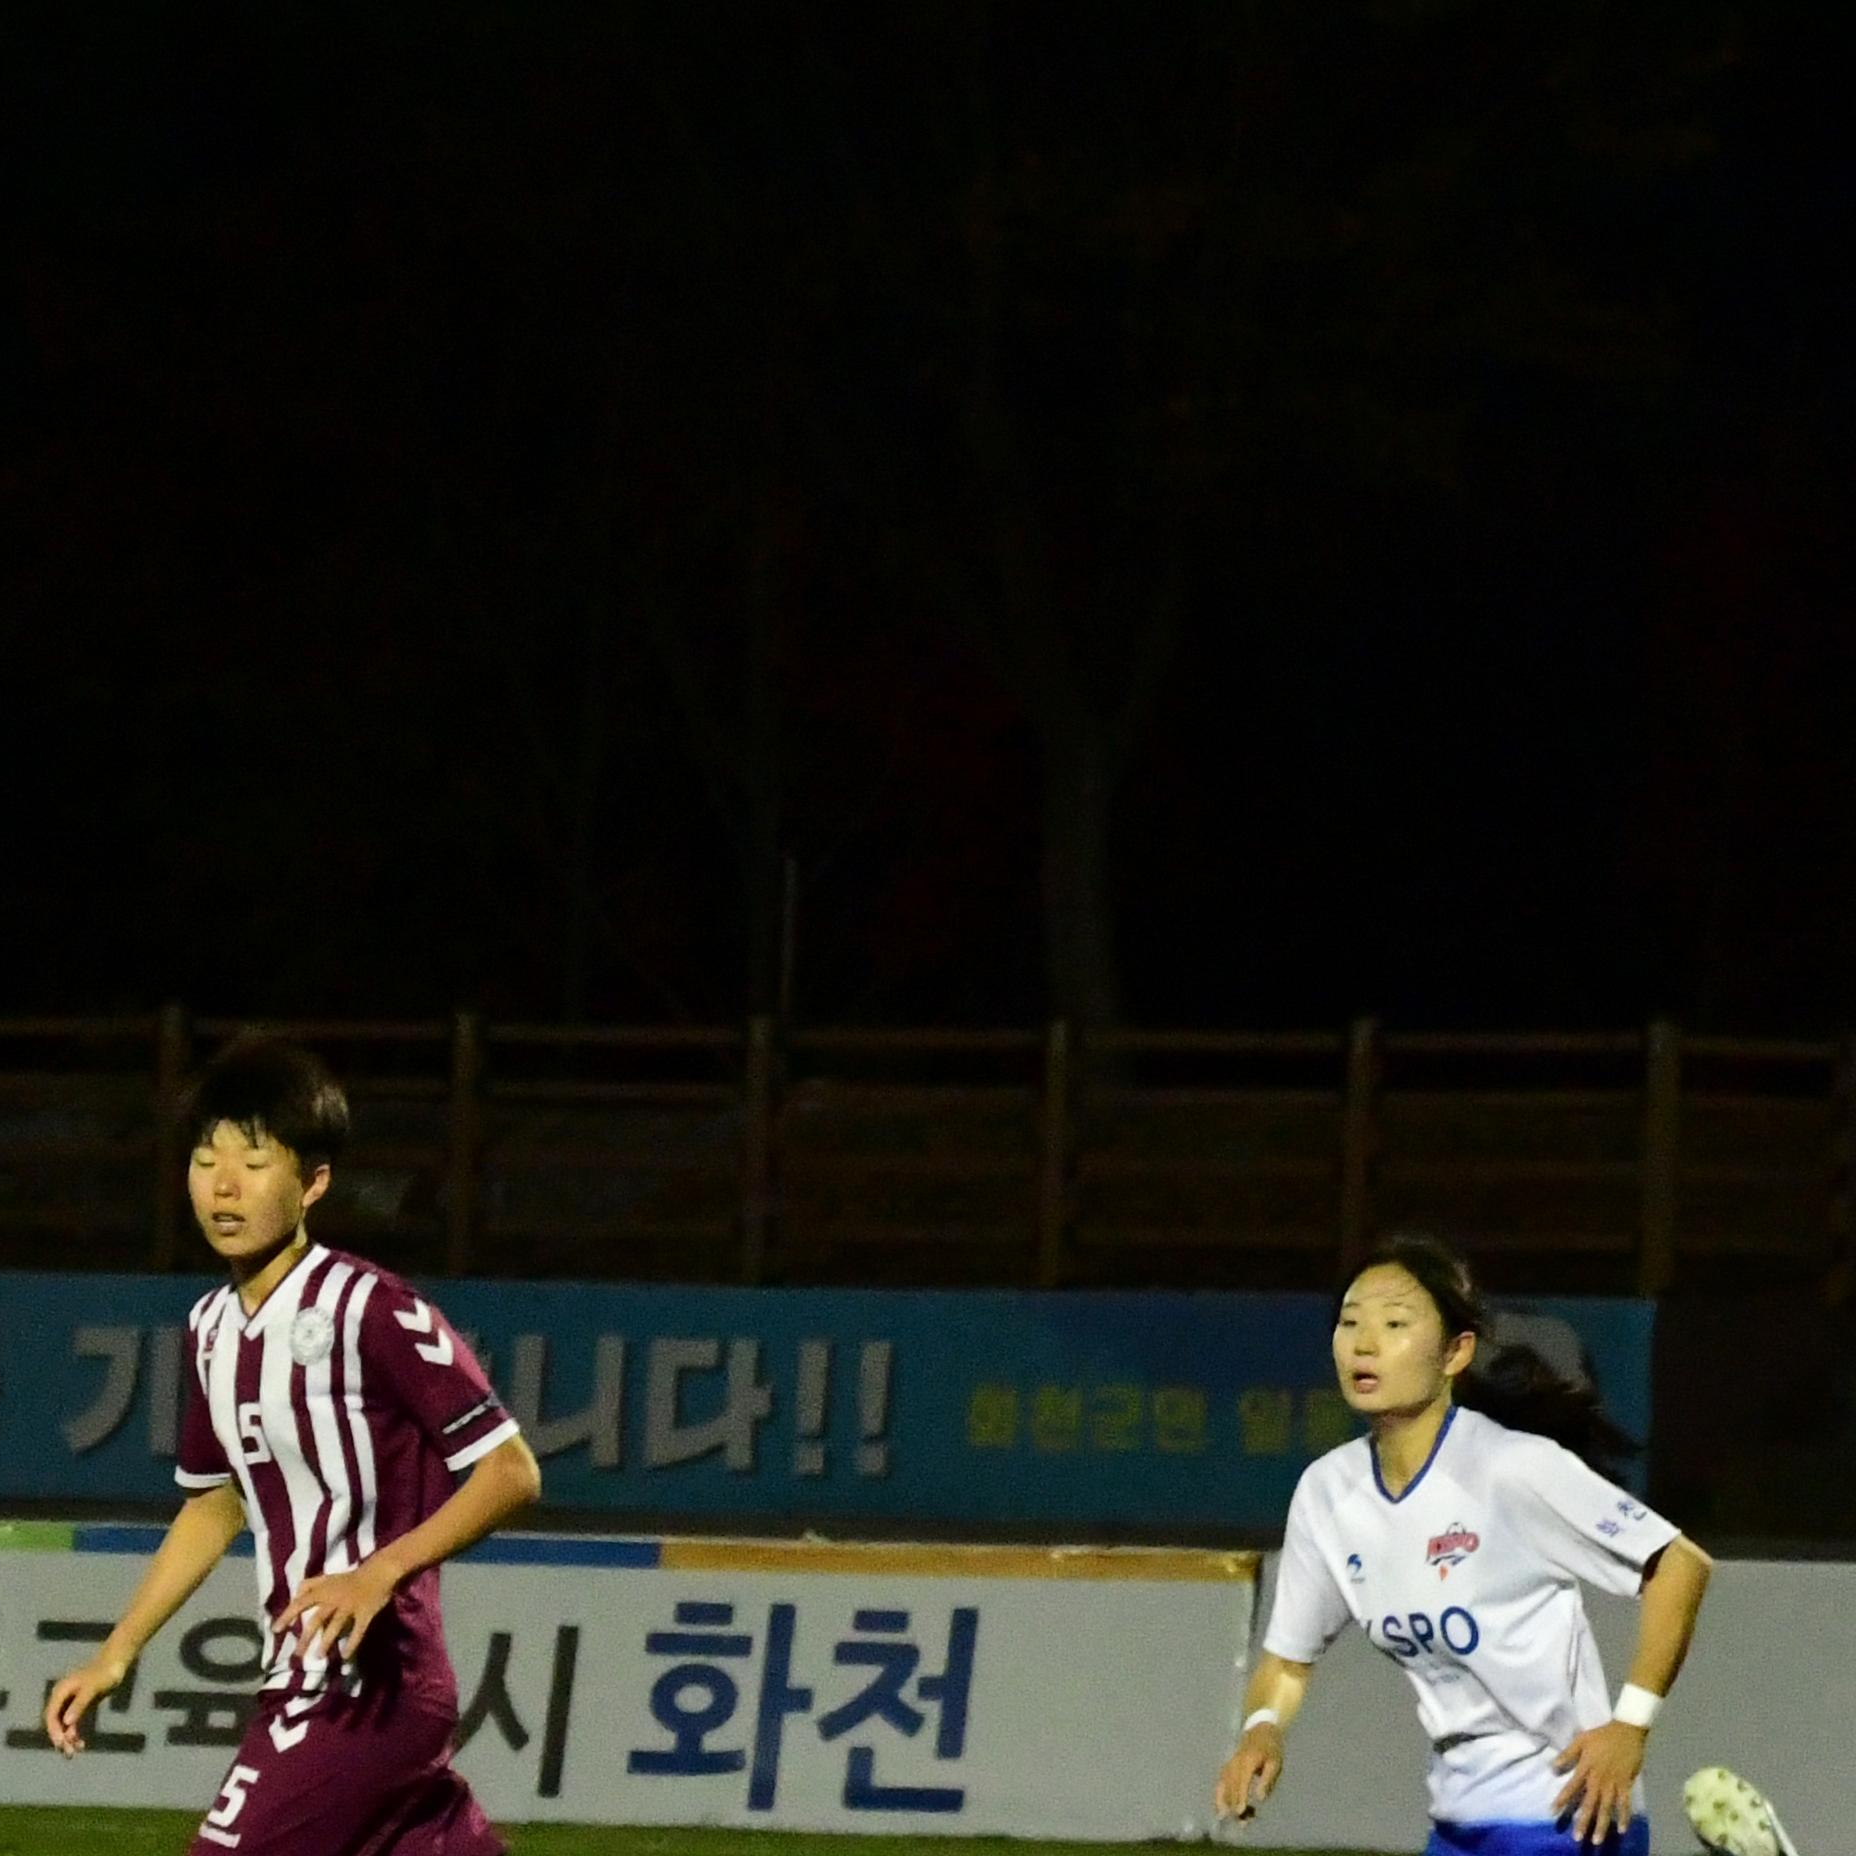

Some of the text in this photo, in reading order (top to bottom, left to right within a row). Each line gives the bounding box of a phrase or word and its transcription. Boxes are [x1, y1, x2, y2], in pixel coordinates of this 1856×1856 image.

[1366, 1606, 1480, 1657] SPO
[627, 1601, 980, 1813] 화천
[207, 1765, 260, 1828] 5
